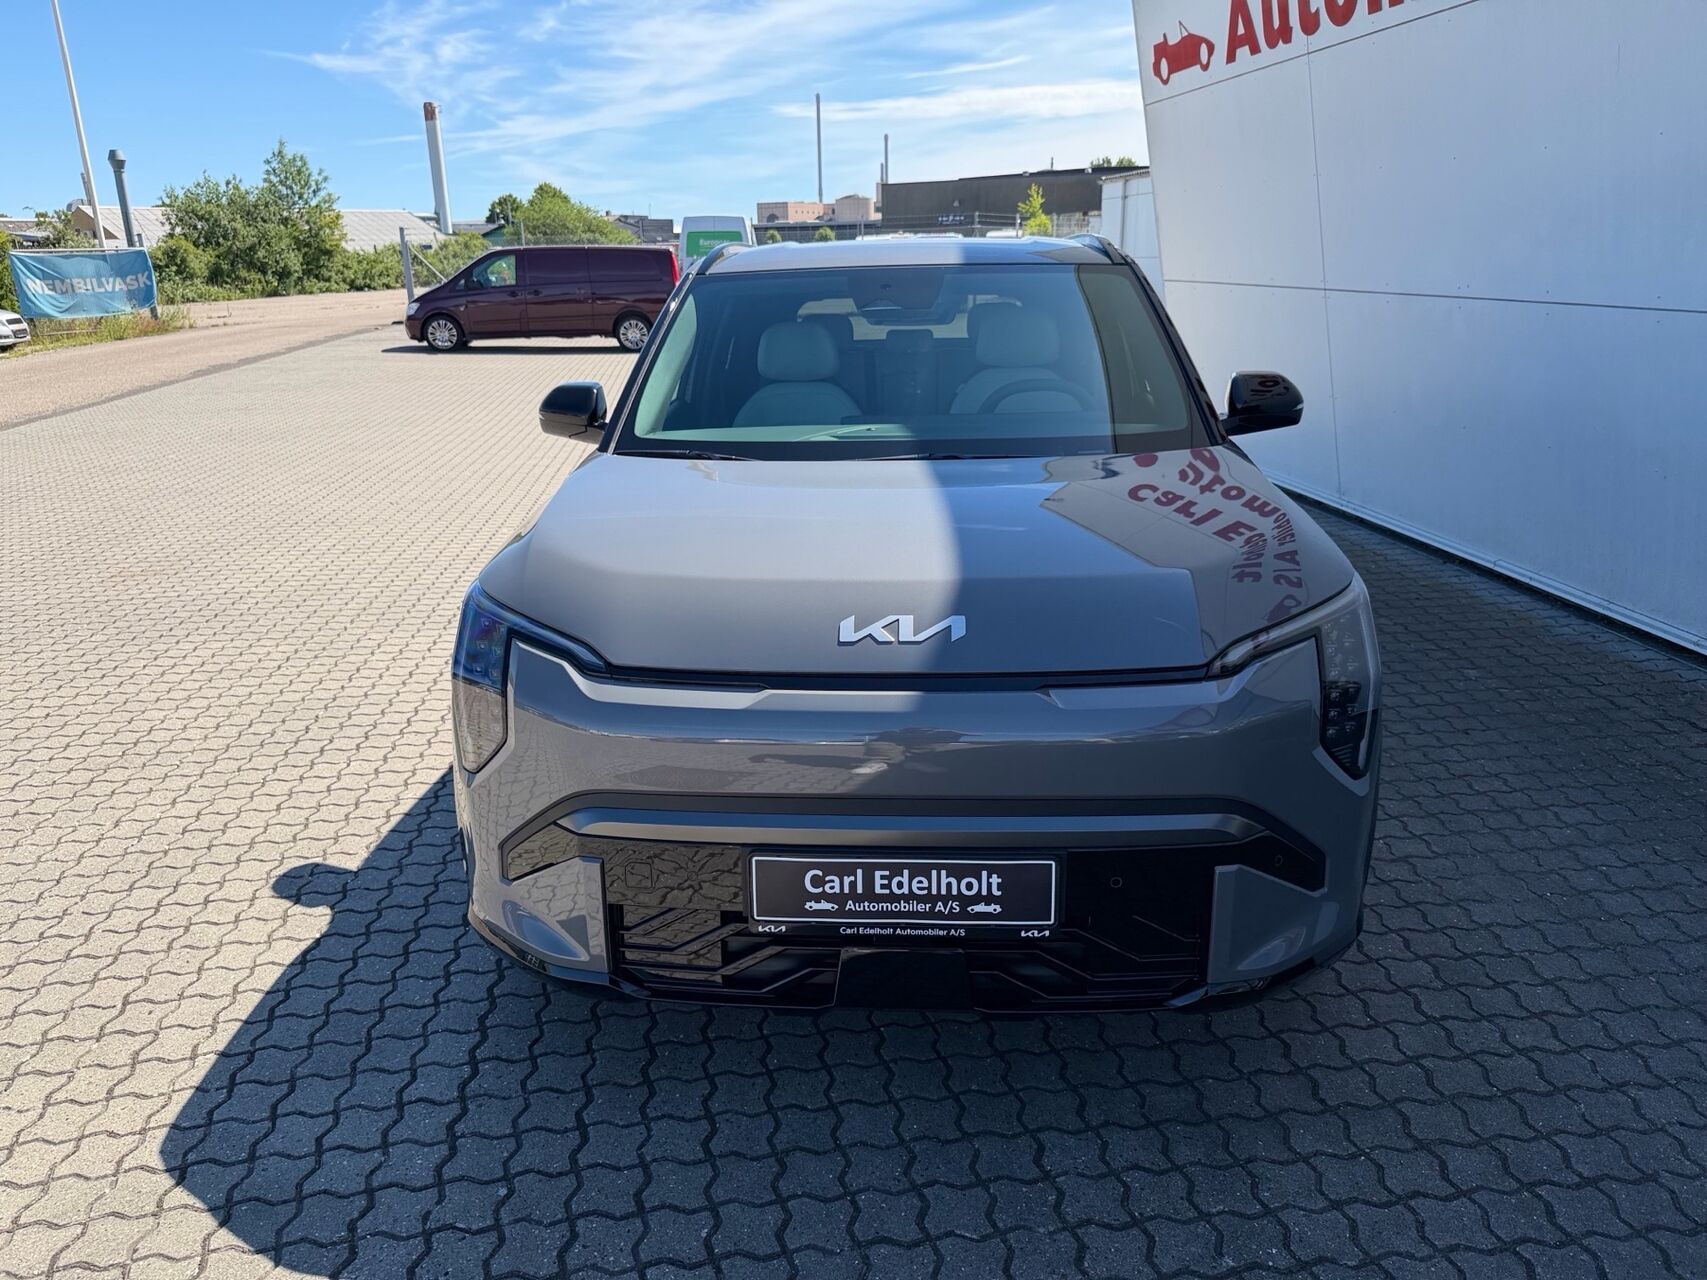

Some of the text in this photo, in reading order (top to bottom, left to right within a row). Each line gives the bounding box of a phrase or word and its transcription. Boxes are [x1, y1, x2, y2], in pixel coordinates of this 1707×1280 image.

[1226, 0, 1410, 64] Auto
[26, 271, 150, 294] NEMBILVASK
[838, 614, 967, 643] KIA
[804, 868, 1002, 896] Carl Edelholt
[845, 899, 960, 914] Automobiler A/S
[758, 924, 786, 933] KIA
[839, 926, 966, 937] Carl Edelholt Automobiler A/S
[1020, 929, 1050, 938] KIA
